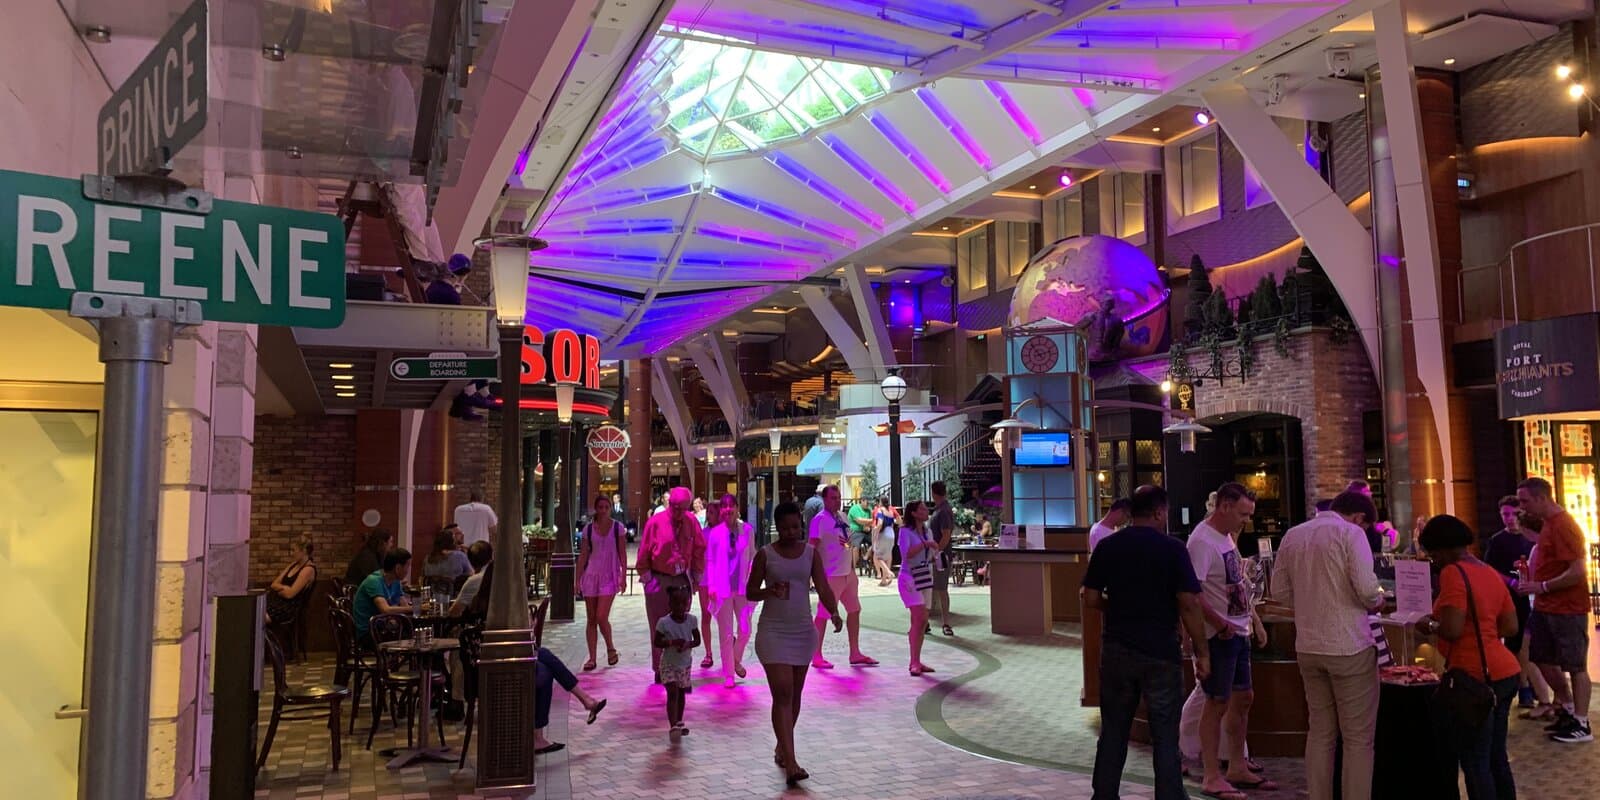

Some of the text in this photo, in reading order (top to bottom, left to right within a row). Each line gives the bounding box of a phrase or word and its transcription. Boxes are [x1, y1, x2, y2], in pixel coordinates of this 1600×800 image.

[103, 22, 199, 176] PRINCE
[15, 194, 331, 310] REENE
[520, 324, 600, 390] SOR
[1506, 354, 1541, 367] PORT
